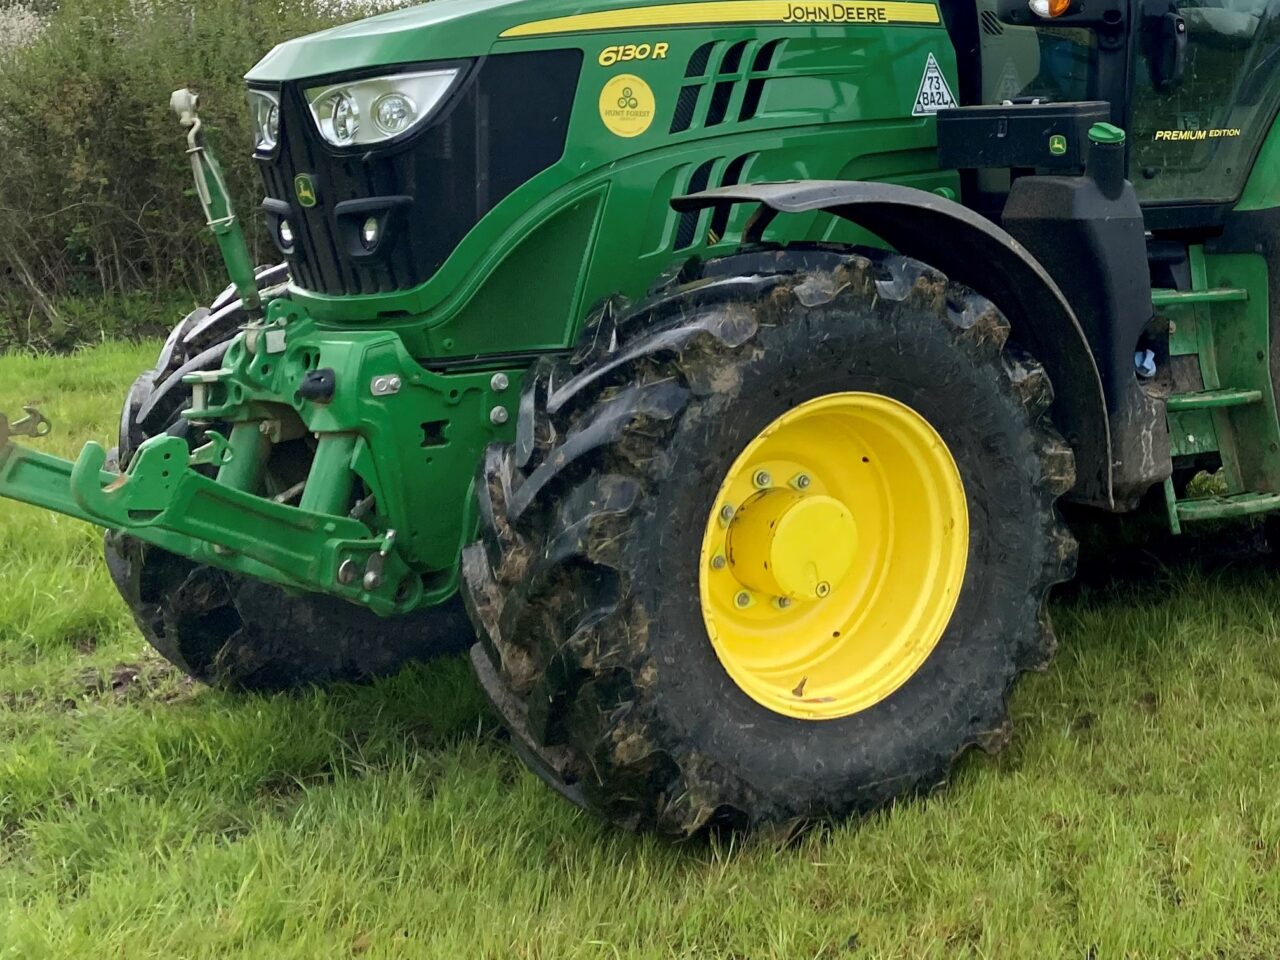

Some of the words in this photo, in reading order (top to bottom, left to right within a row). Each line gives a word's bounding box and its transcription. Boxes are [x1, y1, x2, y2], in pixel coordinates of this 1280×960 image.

[783, 3, 830, 21] JOHN
[832, 3, 888, 22] DEERE
[598, 43, 651, 66] 6130
[652, 42, 669, 59] R
[927, 76, 940, 90] 73
[1154, 130, 1207, 141] PREMIUM
[1208, 128, 1241, 138] EDITION
